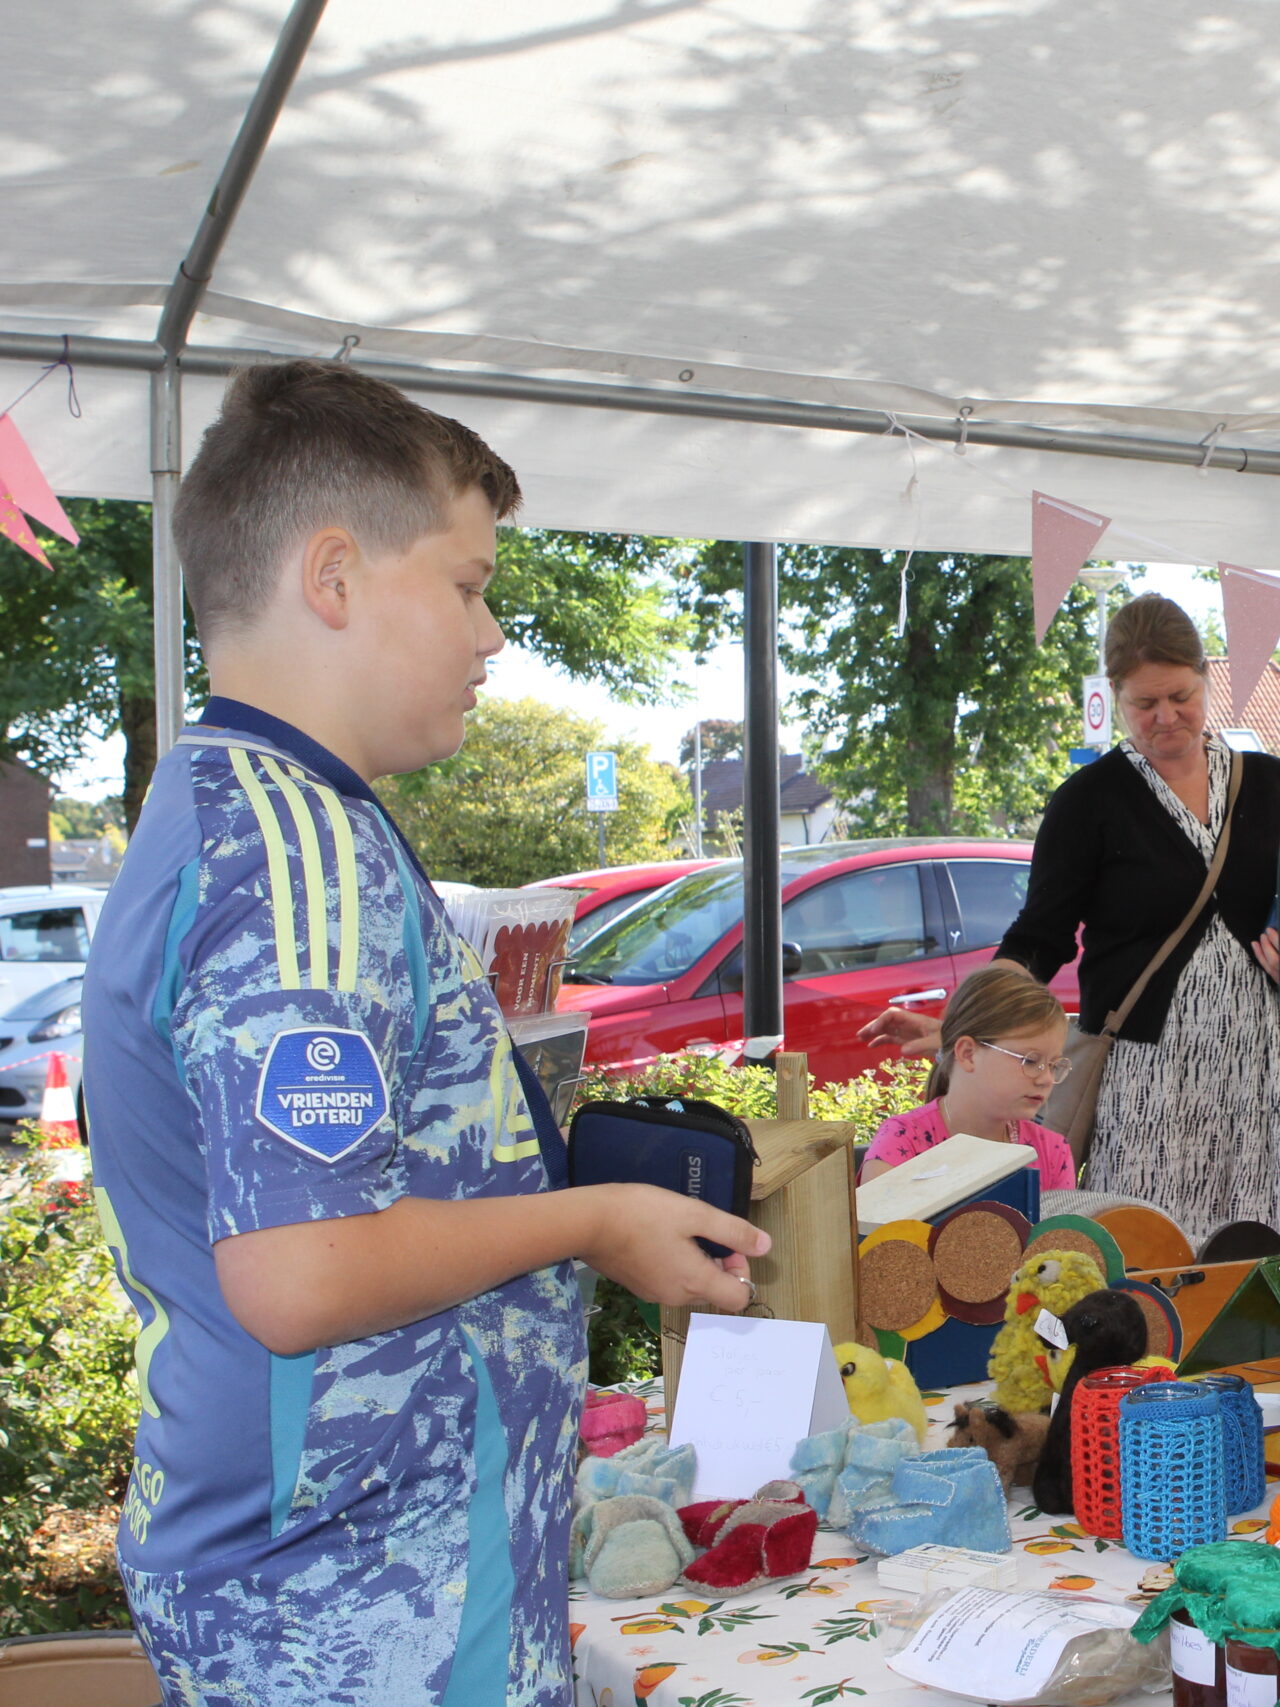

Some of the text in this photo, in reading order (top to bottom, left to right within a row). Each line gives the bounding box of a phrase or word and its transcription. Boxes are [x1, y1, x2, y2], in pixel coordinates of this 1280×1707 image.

[592, 756, 608, 779] P
[514, 952, 529, 1012] VOOR EEN
[305, 1074, 346, 1082] eredivisie
[277, 1092, 373, 1109] VRIENDEN
[292, 1108, 363, 1127] LOTERIJ
